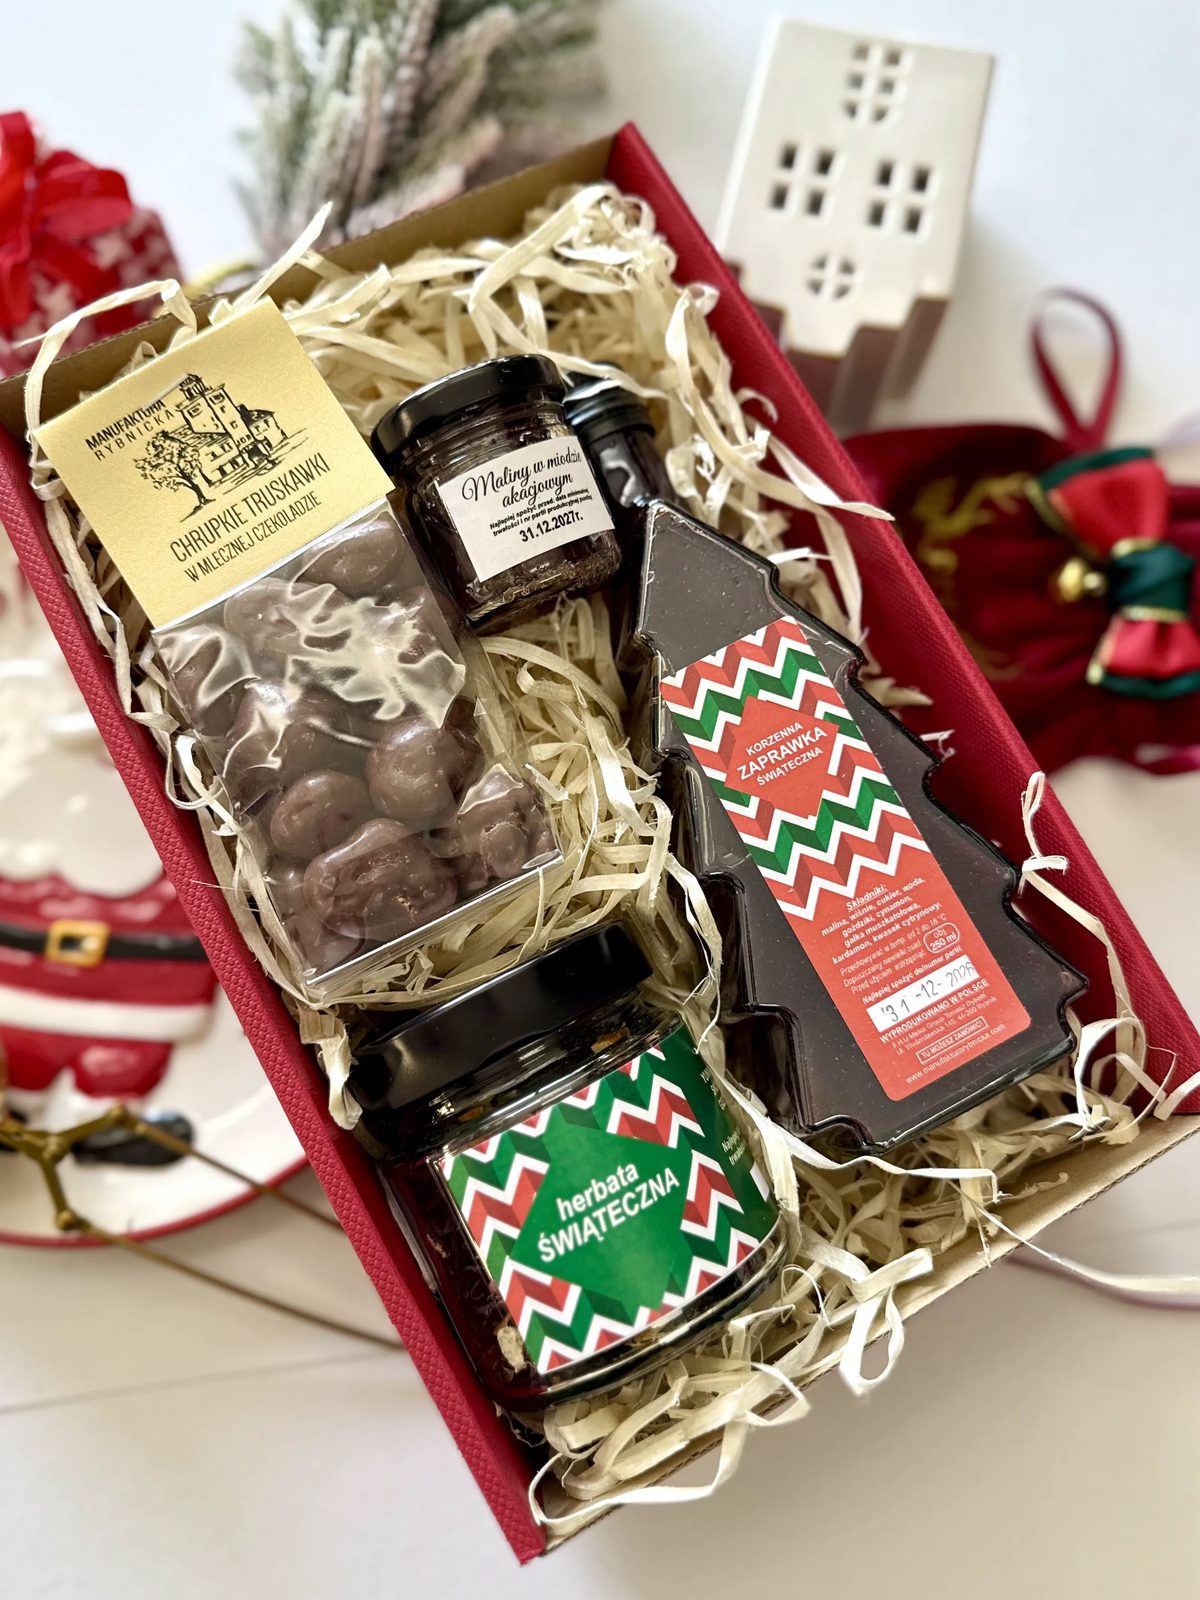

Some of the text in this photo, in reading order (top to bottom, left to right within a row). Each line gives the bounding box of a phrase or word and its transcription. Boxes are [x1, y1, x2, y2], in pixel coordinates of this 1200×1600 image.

[85, 399, 166, 450] MANUFAKTURA
[94, 410, 175, 461] RYBNICKA
[461, 446, 583, 502] Maliny w miodzie
[502, 472, 574, 508] akacjowym
[170, 452, 331, 562] CHRUPKIE TRUSKAWKI
[490, 514, 515, 530] Najlepiej
[493, 520, 520, 536] trwałości
[531, 509, 546, 520] partii
[519, 510, 584, 542] 31.12.2027r.
[184, 490, 322, 584] W MLECZNEJ CZEKOLADZIE
[737, 727, 827, 780] ZAPRAWKA
[746, 722, 803, 756] KORZENNA
[757, 747, 823, 785] ŚWIĄTECZNA
[822, 919, 849, 936] malina,
[876, 890, 902, 906] cukier,
[902, 878, 925, 892] woda,
[846, 884, 888, 912] Składniki:
[876, 896, 912, 917] cynamon,
[832, 941, 872, 964] kardamon,
[872, 923, 901, 942] kwasek
[844, 903, 920, 948] gałka muszkatołowa,
[907, 930, 916, 939] od
[930, 932, 957, 951] 250 ml
[862, 985, 891, 1004] Najlepiej
[891, 973, 913, 988] spożyć
[880, 979, 988, 1043] WYPRODUKOWANO W POLSCE
[921, 1050, 931, 1058] TU
[556, 1163, 639, 1222] herbata
[537, 1167, 680, 1262] ŚWIĄTECZNA
